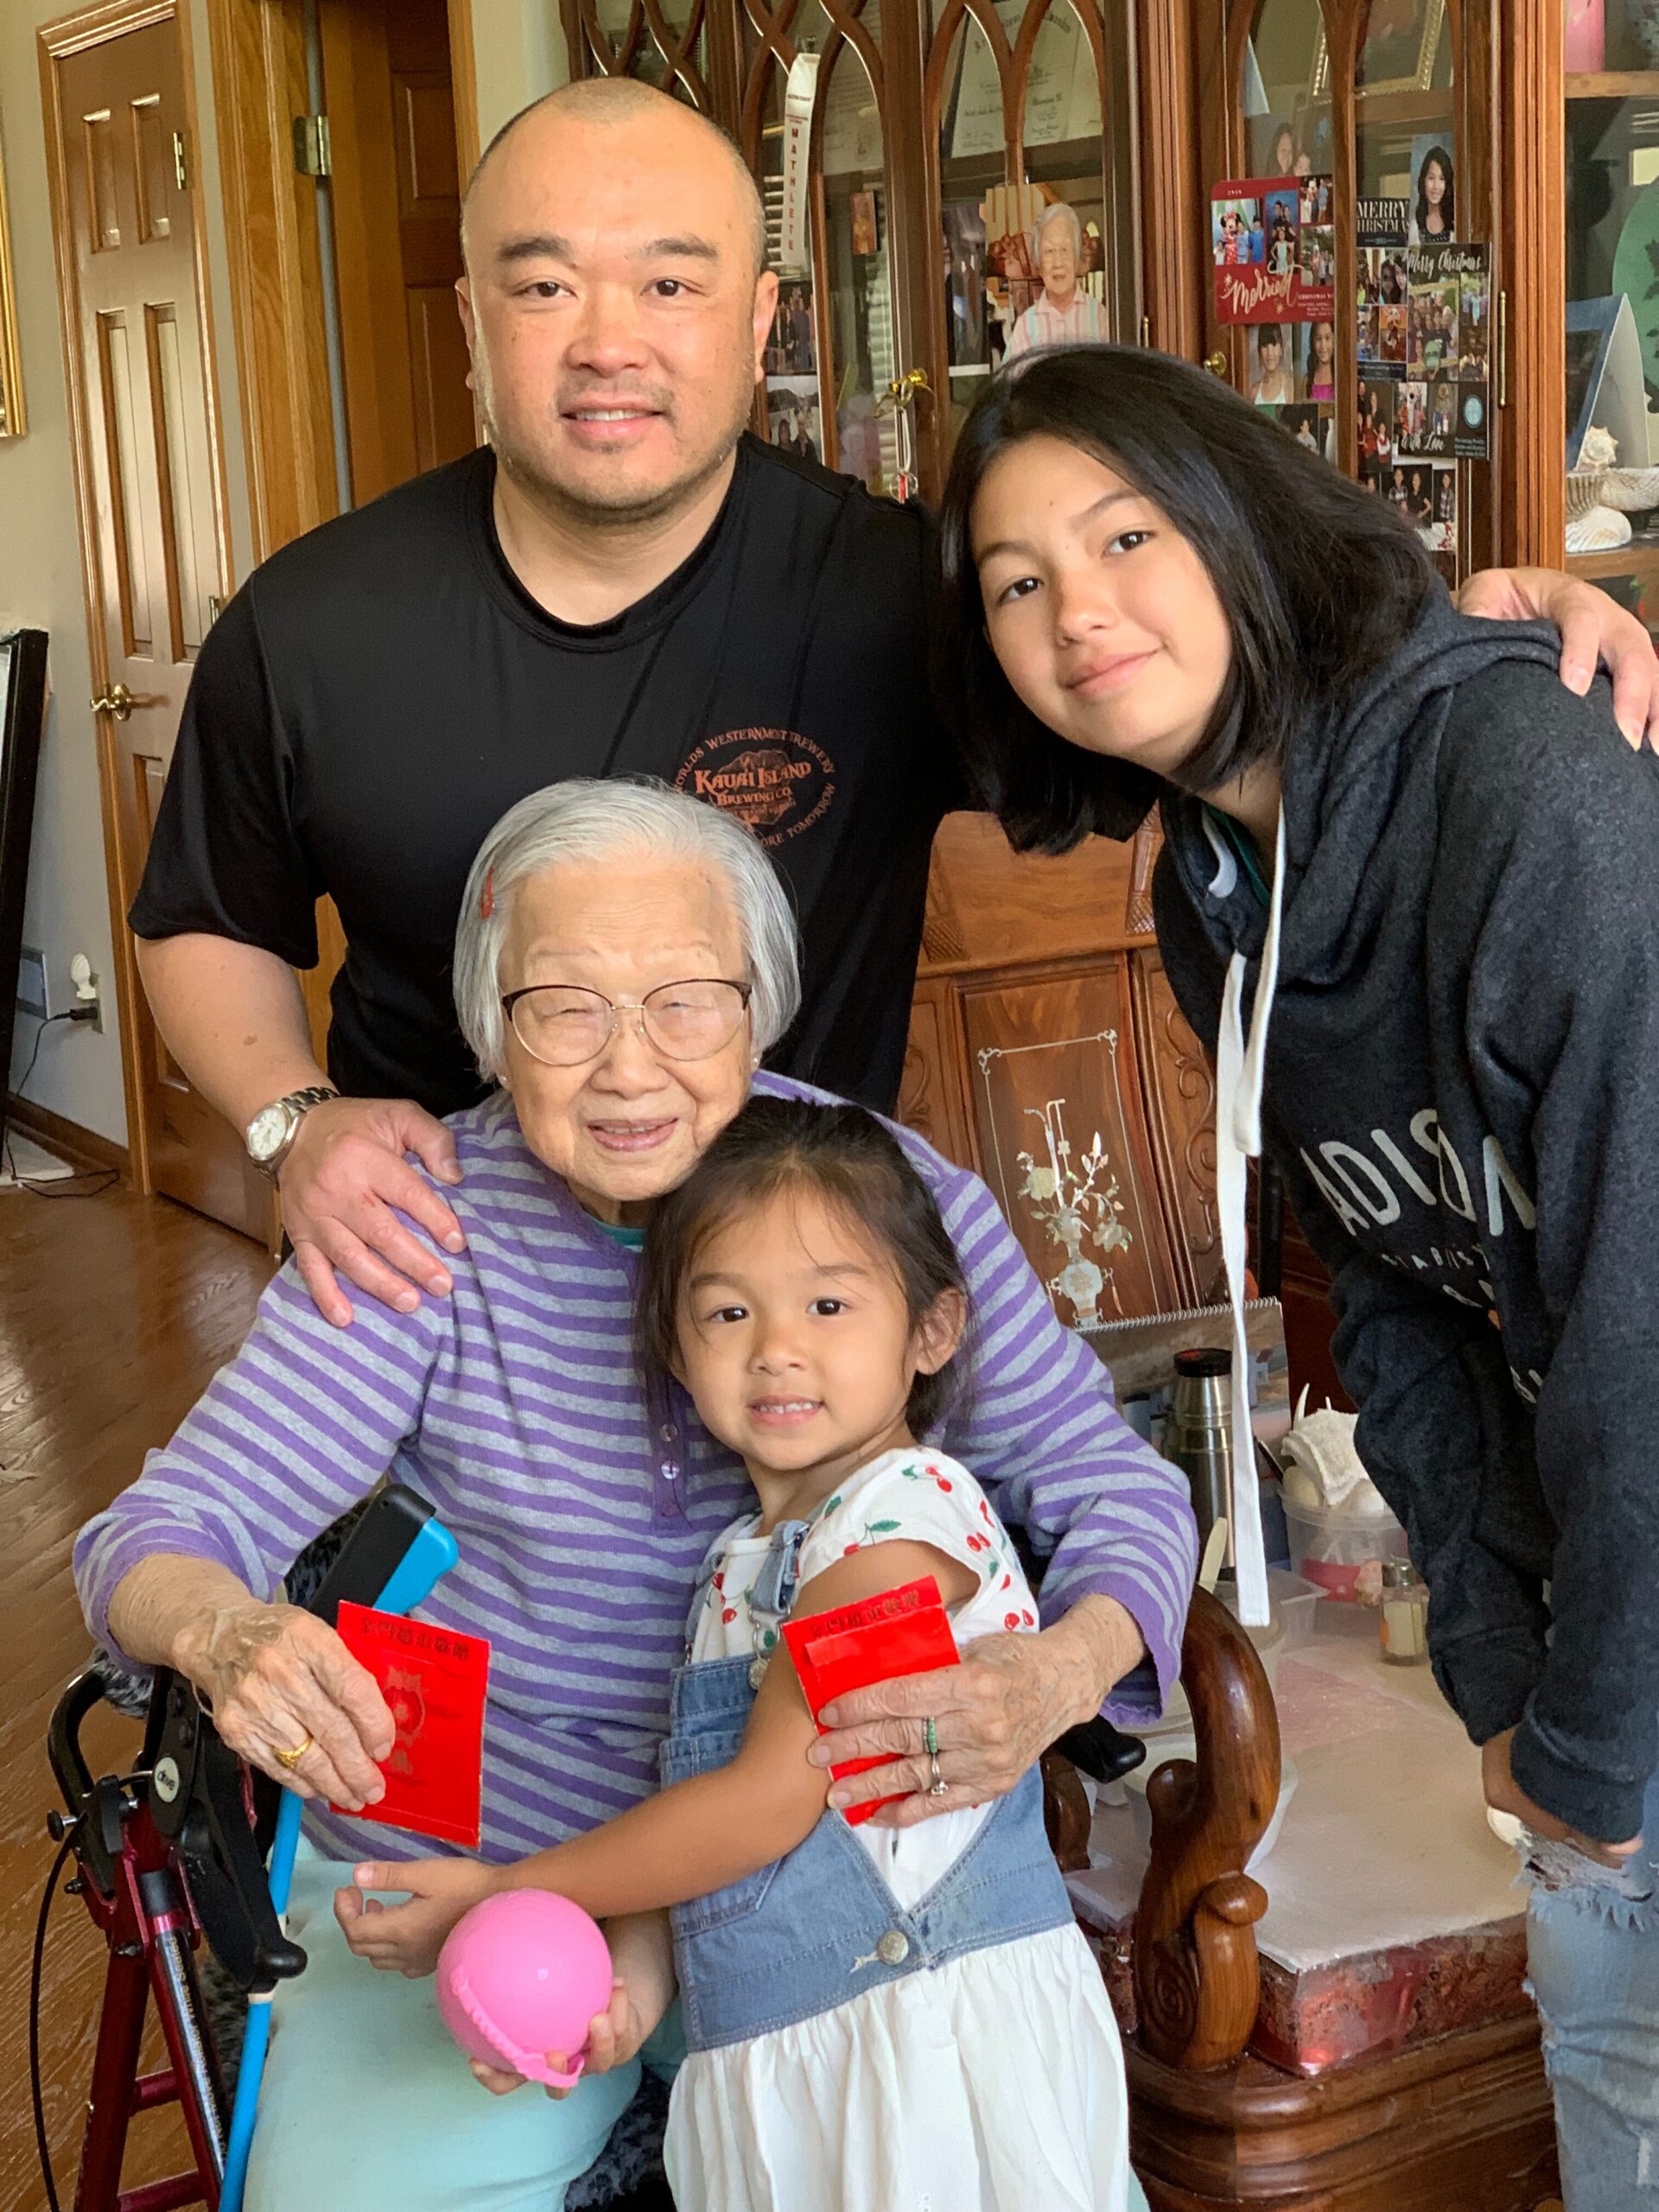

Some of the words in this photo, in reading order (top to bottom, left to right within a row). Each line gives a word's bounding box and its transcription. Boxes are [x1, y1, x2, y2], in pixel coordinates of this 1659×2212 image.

[788, 127, 799, 251] MATHLETE
[1357, 201, 1408, 219] MERRY
[1357, 219, 1409, 233] HRISTMAS
[1438, 248, 1482, 273] Christmas
[675, 747, 705, 791] ORLDS
[694, 769, 756, 795] KAUAI
[758, 761, 812, 789] ISLAND
[716, 792, 775, 806] BREWING
[167, 1936, 187, 1982] Seated
